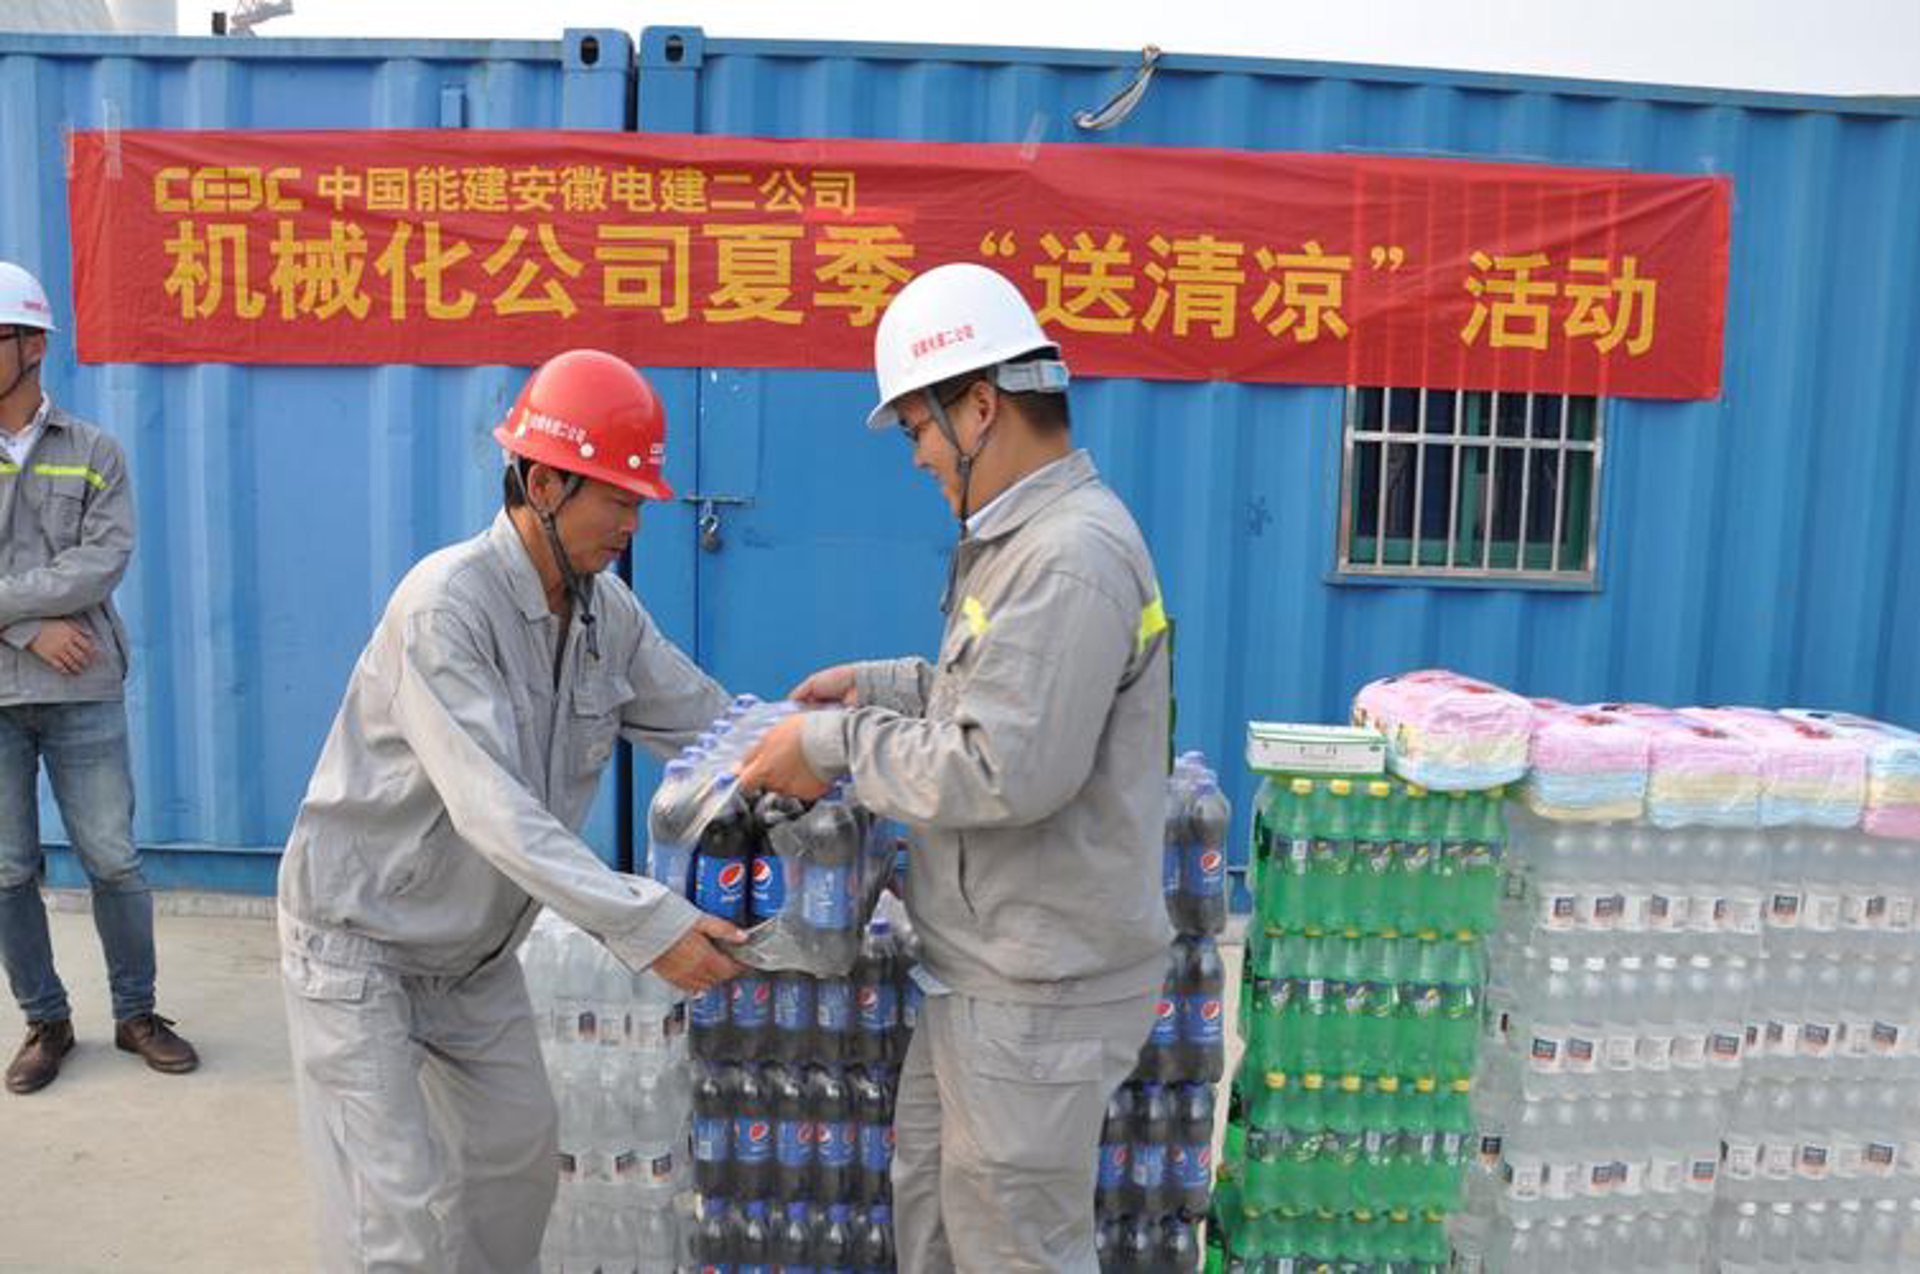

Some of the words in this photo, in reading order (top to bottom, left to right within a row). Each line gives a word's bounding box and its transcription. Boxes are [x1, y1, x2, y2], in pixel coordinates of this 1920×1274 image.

[317, 165, 858, 216] 中国能建安徽电建二公司
